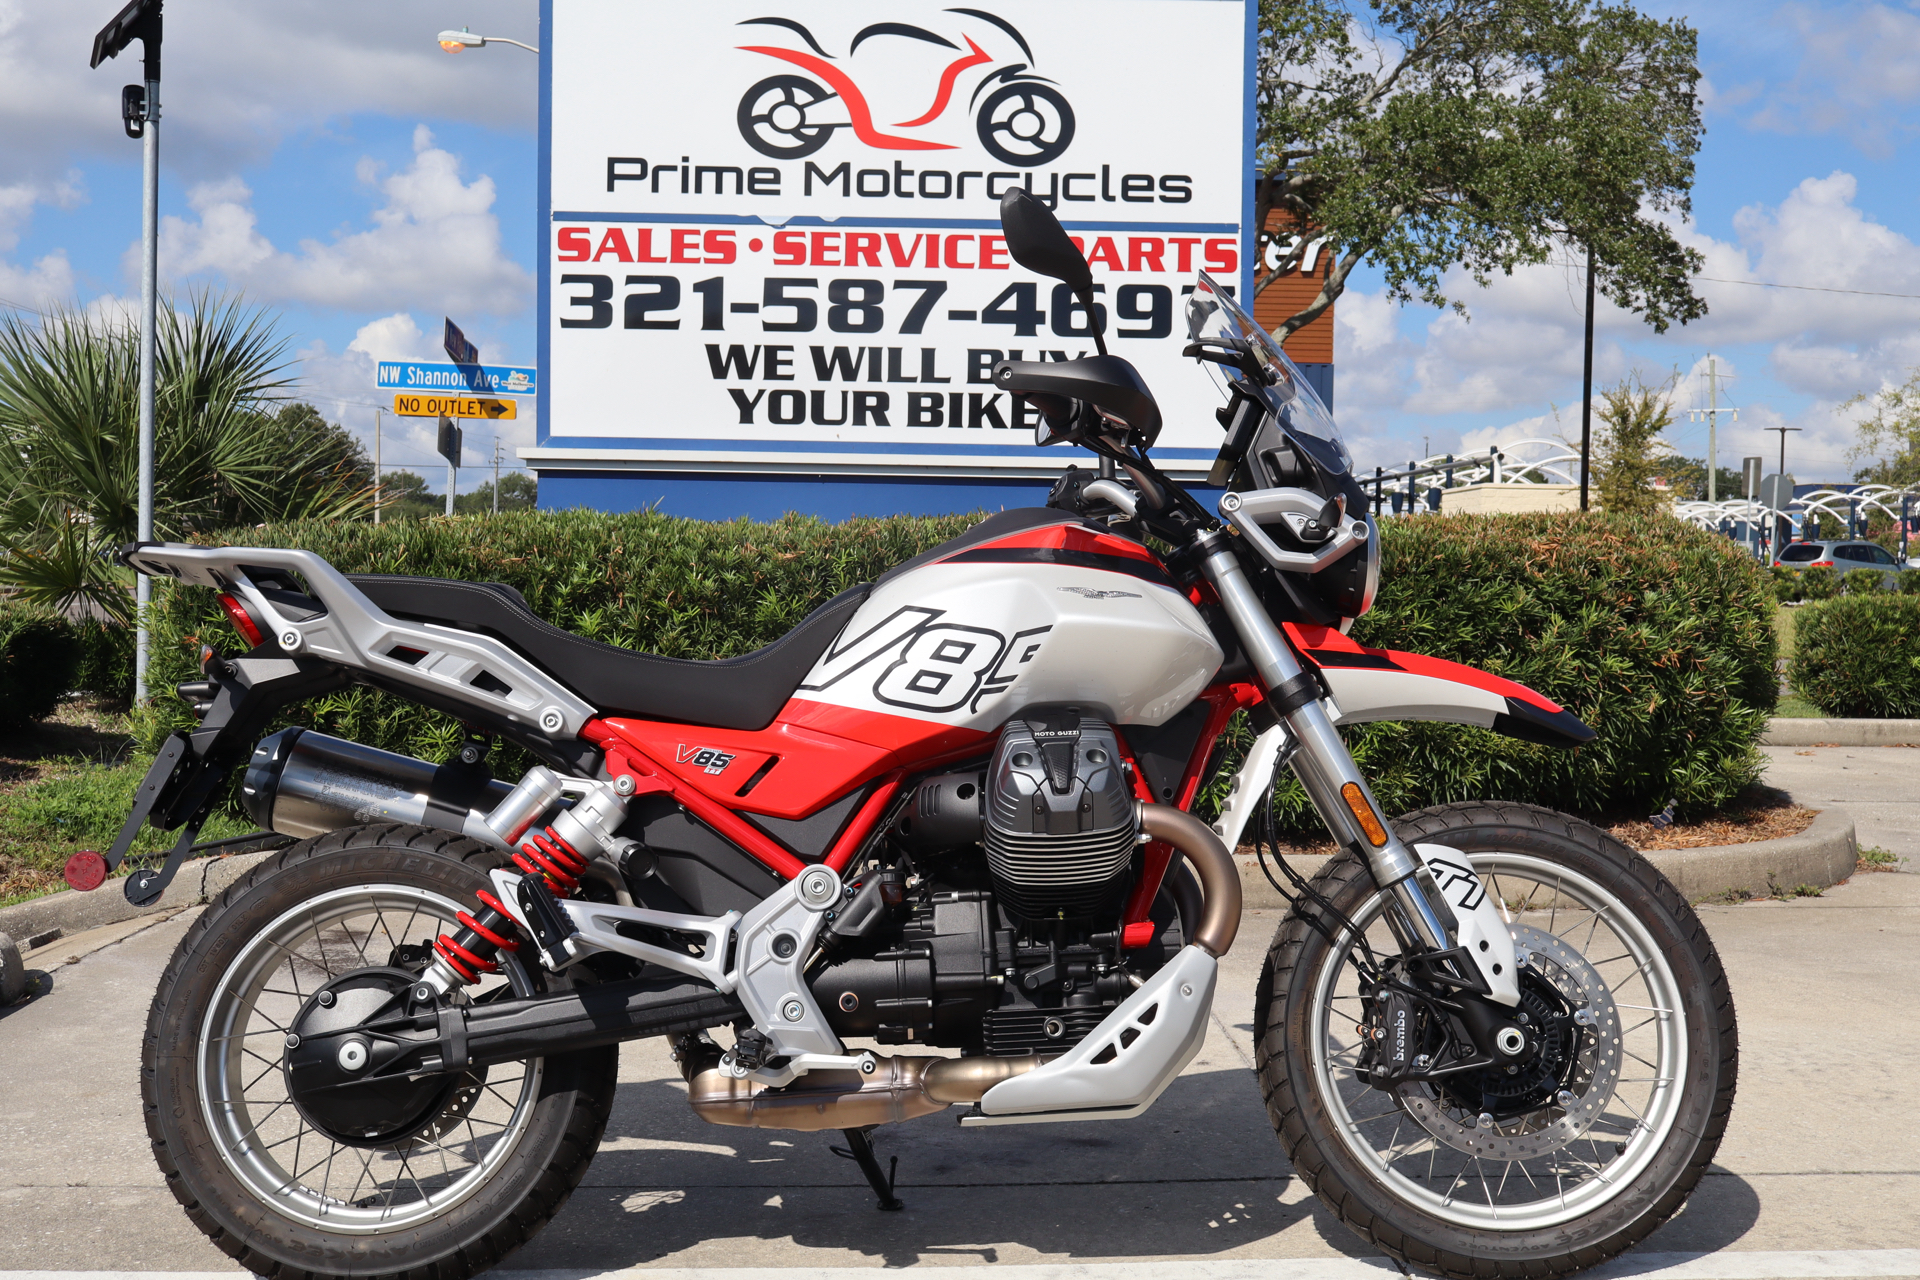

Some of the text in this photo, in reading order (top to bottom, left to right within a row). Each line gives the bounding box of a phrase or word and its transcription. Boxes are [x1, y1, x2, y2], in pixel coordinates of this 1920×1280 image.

[606, 156, 1192, 212] Prime Motorcycles
[557, 227, 737, 264] SALES
[773, 231, 1010, 270] SERVICE
[379, 365, 500, 388] NW Shannon Ave
[704, 344, 796, 381] WE
[809, 345, 952, 384] WILL
[399, 398, 486, 415] NO OUTLET
[727, 388, 1041, 431] YOUR BIKE
[676, 743, 737, 768] V85
[319, 854, 477, 889] MICHELIN
[1392, 1010, 1406, 1062] brembo
[1554, 1181, 1656, 1247] ANAKEE
